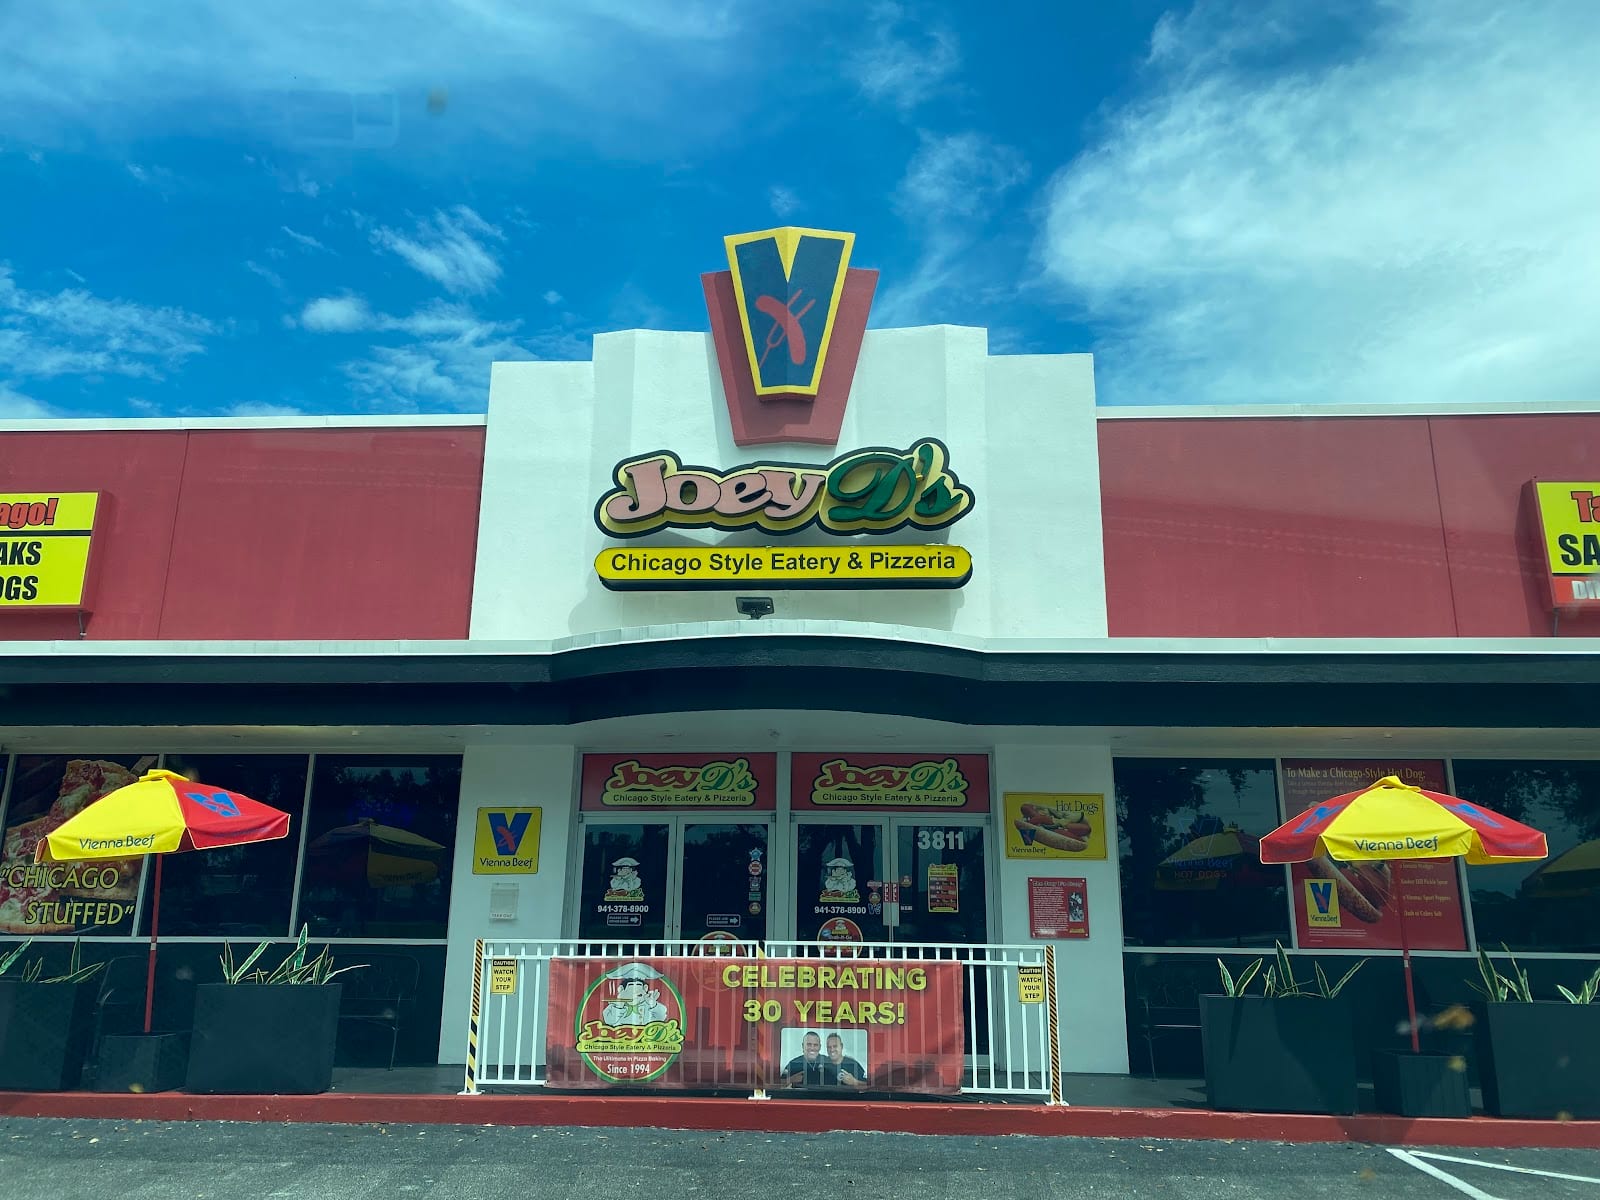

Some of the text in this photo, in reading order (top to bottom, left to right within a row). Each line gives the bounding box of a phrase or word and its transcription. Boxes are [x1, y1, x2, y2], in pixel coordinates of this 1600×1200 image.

[606, 443, 965, 524] Joey D's
[612, 552, 956, 575] Chicago Style Eatery & Pizzeria
[0, 576, 39, 600] GS
[610, 762, 753, 791] Joey D's
[819, 762, 964, 791] Joey D's
[1287, 767, 1296, 778] To
[1298, 767, 1321, 778] Make
[1323, 770, 1328, 778] a
[1330, 767, 1385, 782] Chicago-Style
[613, 794, 746, 804] Chicago Style Eatery & Pizzeria
[822, 793, 958, 803] Chicago Style Eatery & Pizzeria
[1056, 800, 1099, 815] Hot Dogs
[79, 833, 156, 850] Vienna Beef
[917, 831, 965, 850] 3811
[1354, 835, 1439, 852] Vienna Beef
[1011, 846, 1032, 854] Vienna
[480, 857, 533, 869] Vienna Beef
[597, 905, 650, 913] 941-378-8900
[814, 906, 867, 914] 941-378-8900
[722, 964, 928, 991] CELEBRATING
[743, 999, 905, 1025] 30 YEARS!
[583, 1020, 684, 1042] Joey D's
[583, 1044, 609, 1053] Chicago
[610, 1044, 625, 1052] Style
[625, 1044, 645, 1053] Eatery
[653, 1044, 677, 1052] Pizzeria
[633, 1055, 648, 1063] Pizza
[648, 1055, 667, 1064] Baking
[607, 1063, 651, 1075] Since 1994
